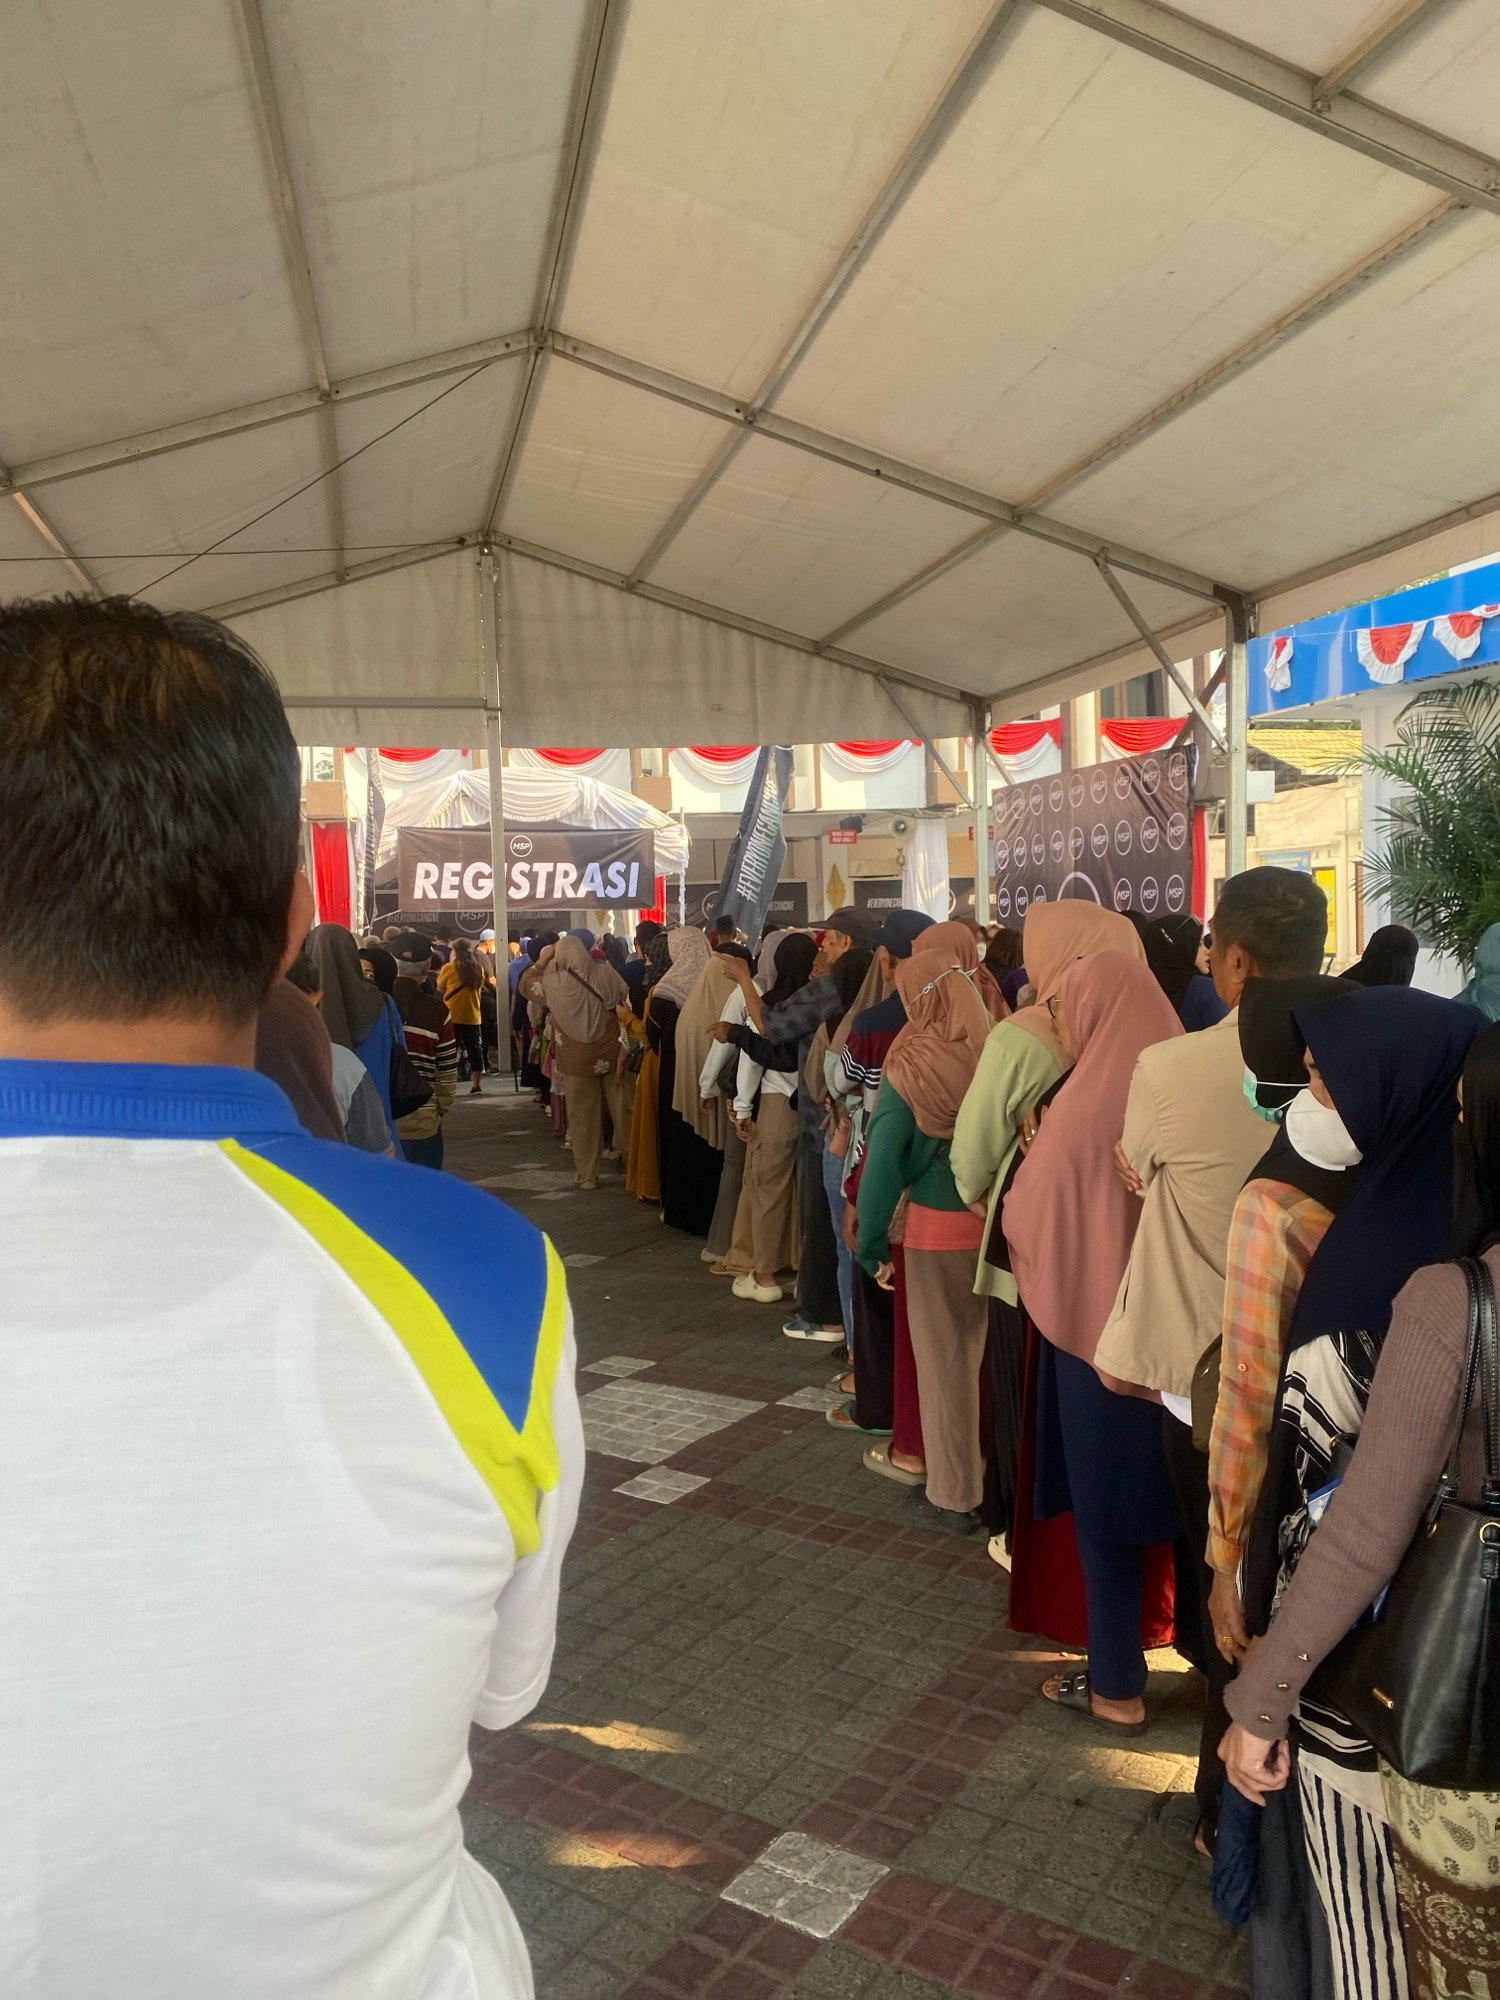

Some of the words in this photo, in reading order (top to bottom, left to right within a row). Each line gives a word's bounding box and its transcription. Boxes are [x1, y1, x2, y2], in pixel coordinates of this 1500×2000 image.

[1143, 770, 1159, 782] MSP
[1171, 765, 1187, 777] MSP
[1093, 781, 1105, 791] MSP
[1117, 776, 1130, 786] MSP
[1143, 828, 1158, 840] MSP
[1169, 825, 1185, 836] MSP
[1093, 835, 1107, 845] MSP
[1117, 832, 1130, 842] MSP
[513, 842, 530, 850] MSP
[413, 861, 640, 899] REGSTRASI
[1117, 890, 1130, 900] MSP
[1143, 889, 1157, 899] MSP
[1168, 888, 1183, 898] MSP
[999, 898, 1009, 907] MSP
[1017, 897, 1027, 905] MSP
[460, 911, 485, 921] MSP
